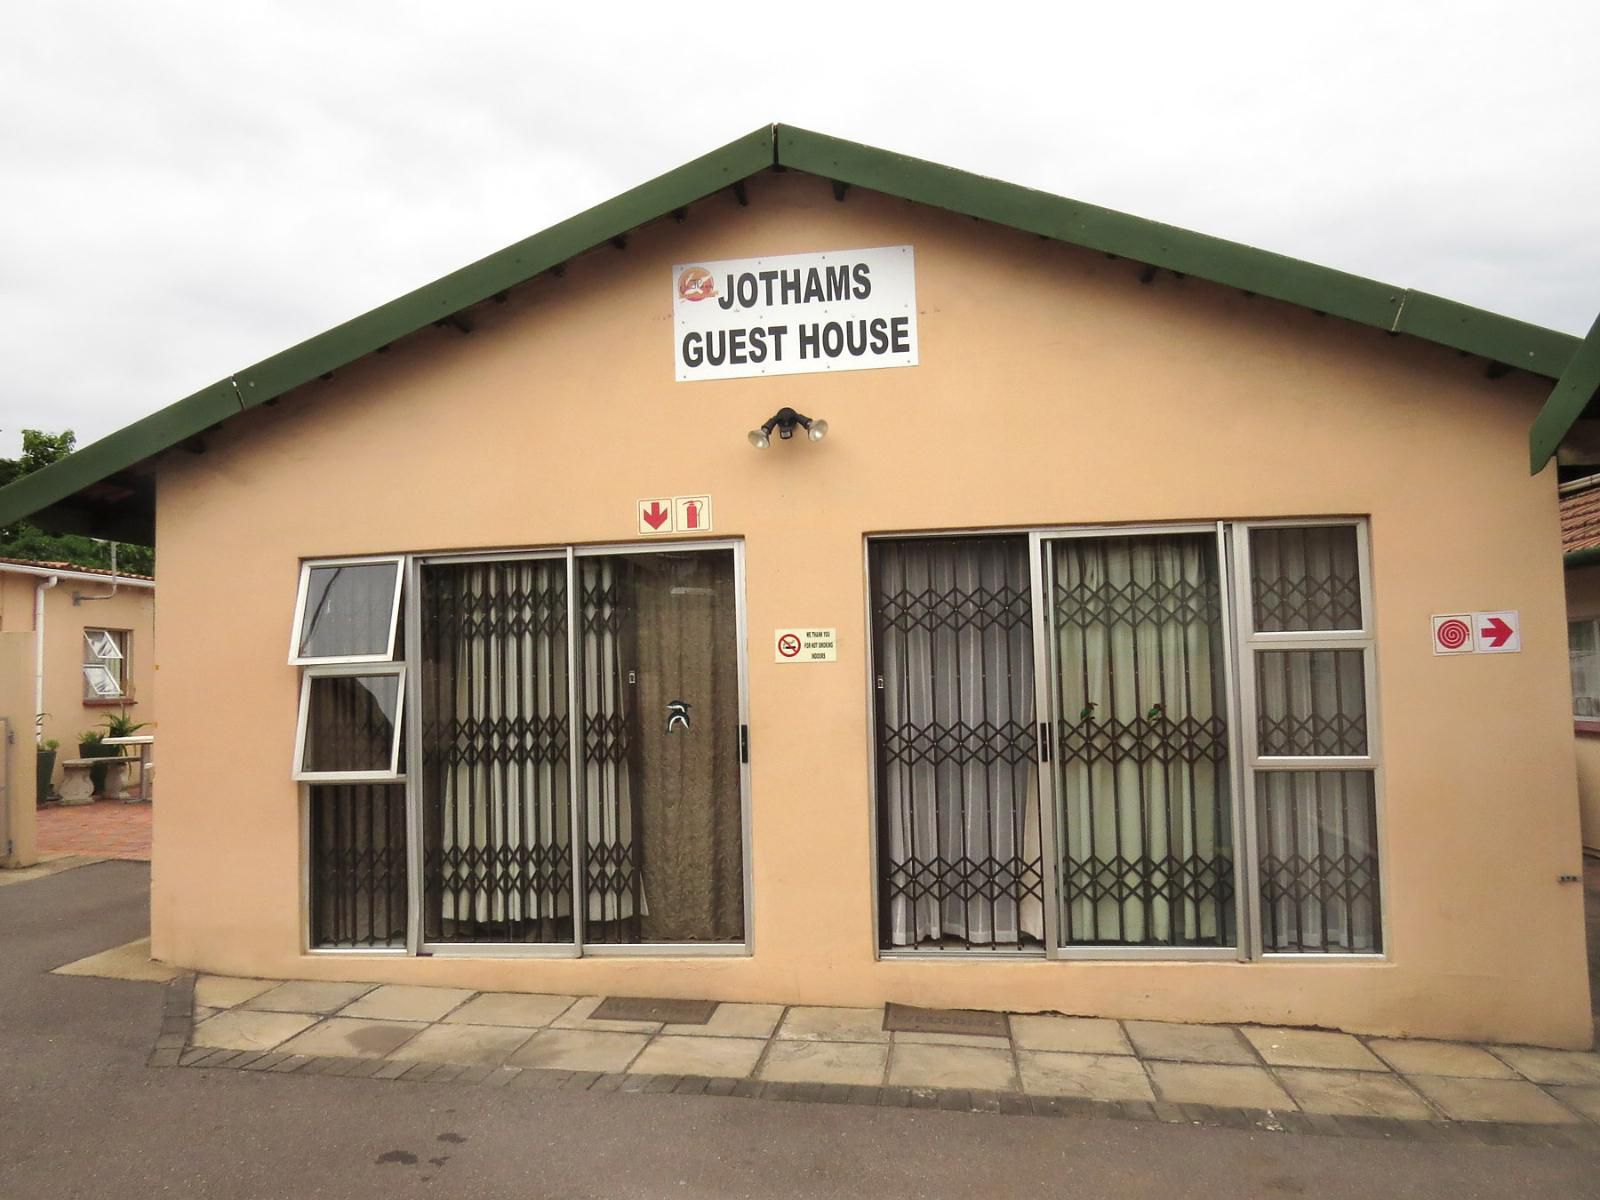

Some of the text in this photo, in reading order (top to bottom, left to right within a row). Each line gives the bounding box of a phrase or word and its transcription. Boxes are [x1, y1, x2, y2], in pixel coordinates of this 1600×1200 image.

[718, 263, 871, 310] JOTHAMS
[682, 316, 910, 367] GUEST HOUSE
